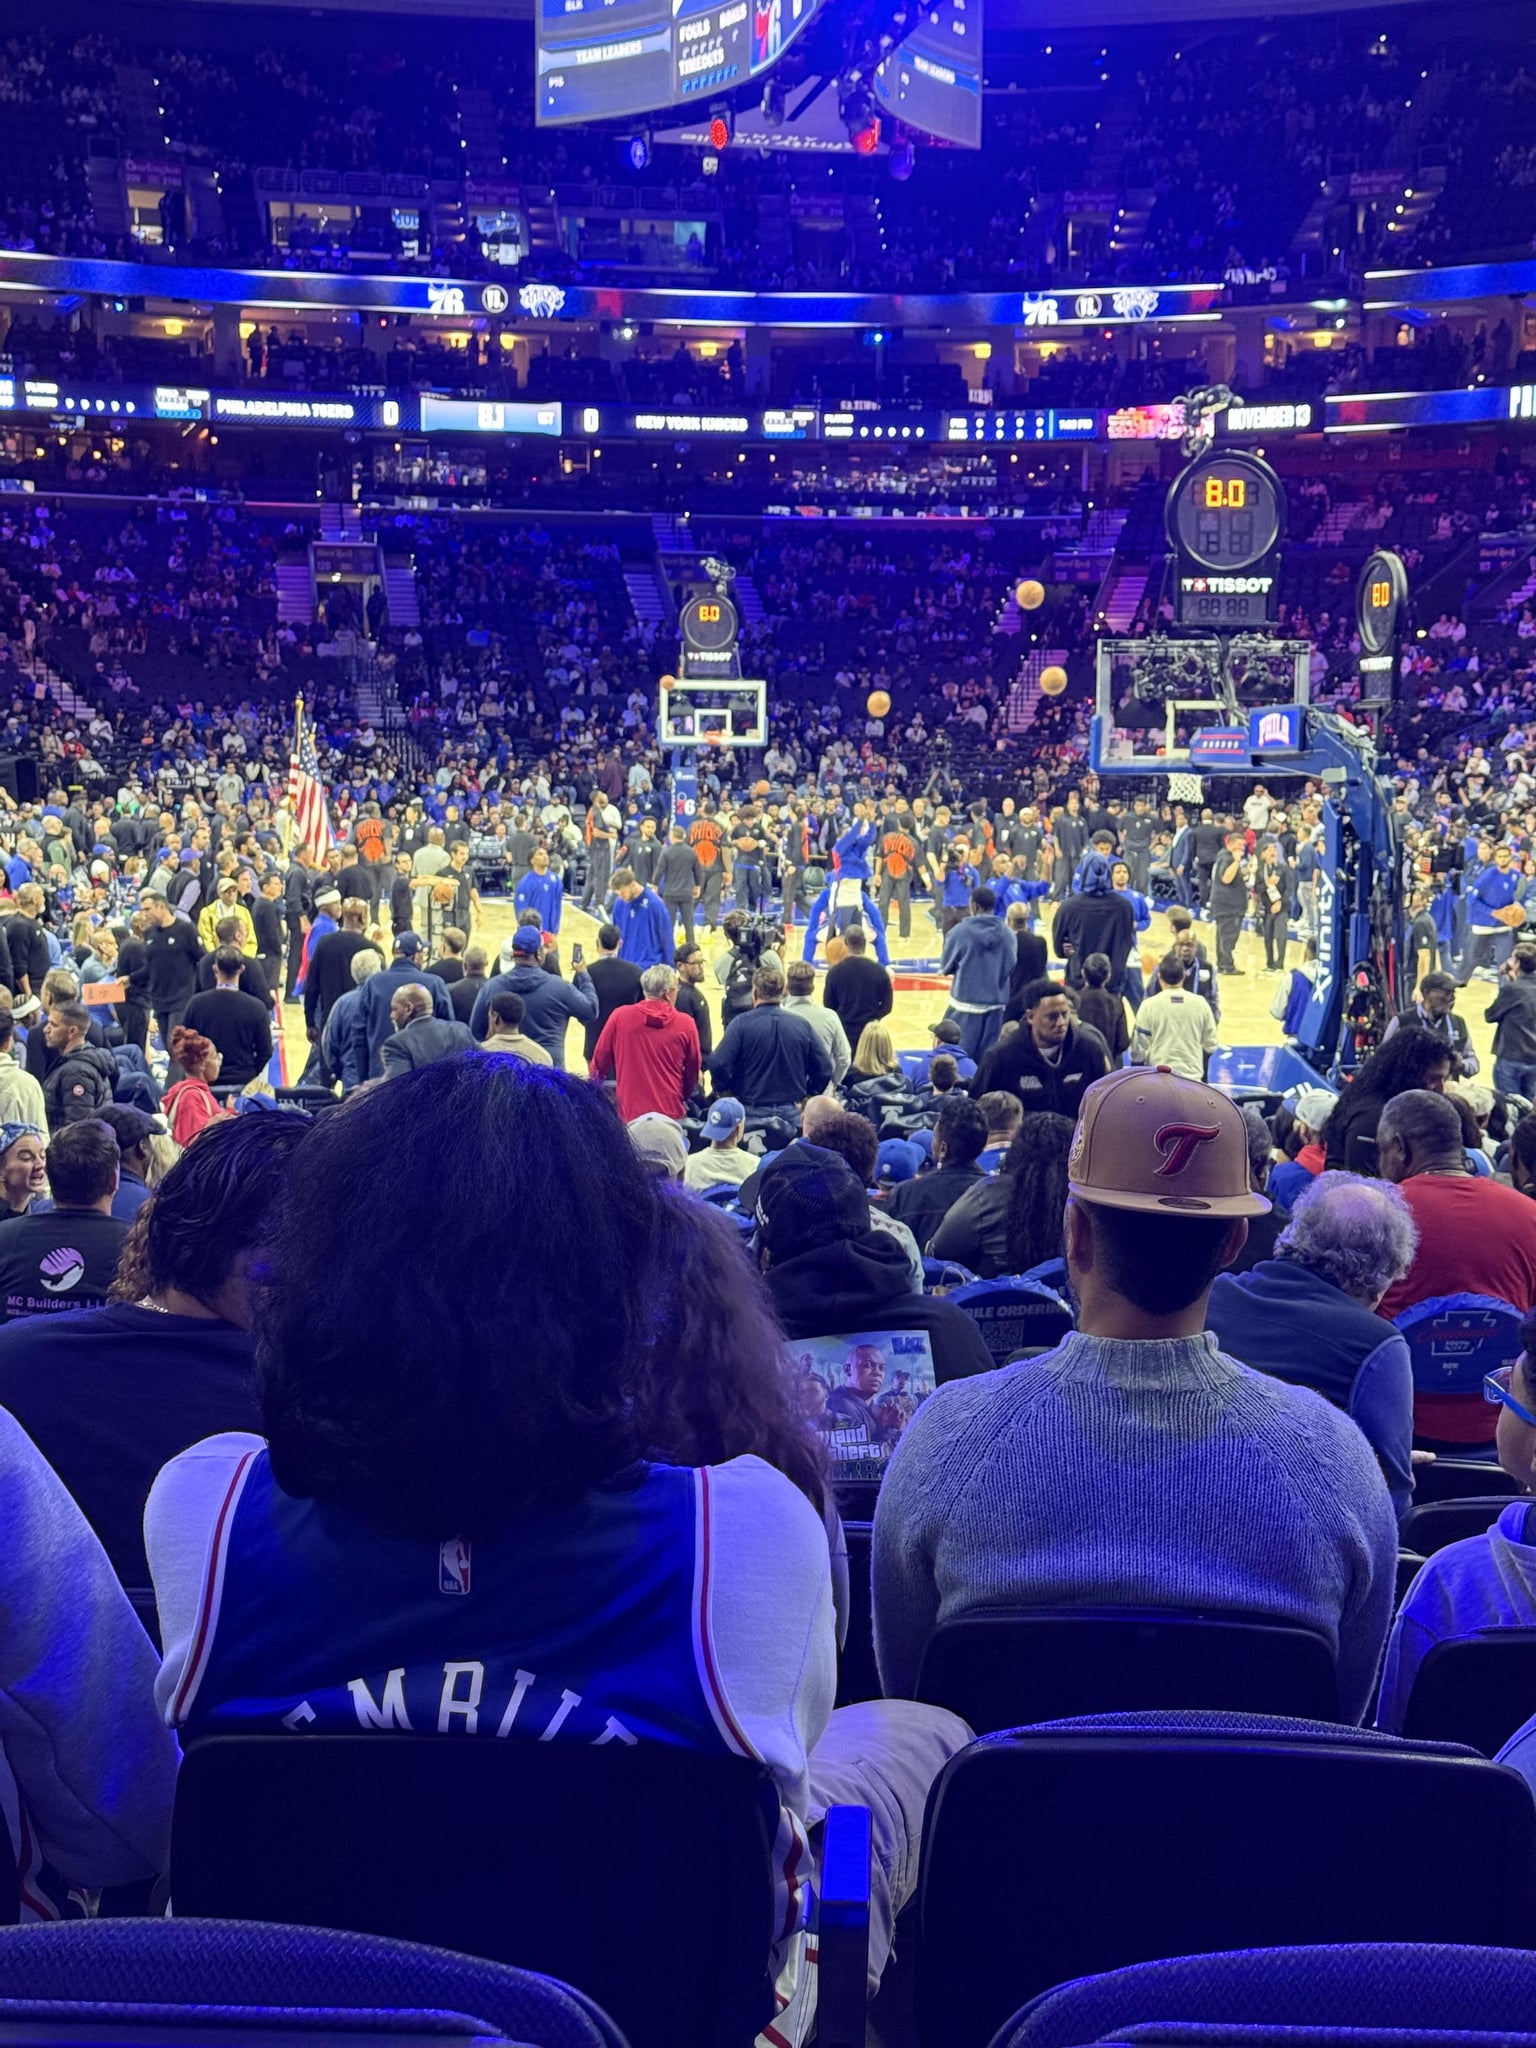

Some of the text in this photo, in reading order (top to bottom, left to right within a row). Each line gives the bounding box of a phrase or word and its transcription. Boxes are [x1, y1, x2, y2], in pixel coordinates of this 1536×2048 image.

[678, 18, 711, 43] FOULS
[576, 40, 643, 64] TEAM LEADERS
[678, 49, 725, 76] TIMEOUTS
[216, 398, 312, 418] PHILADELPHIA
[312, 403, 355, 420] 76ERS
[383, 400, 399, 427] 0
[583, 407, 599, 433] 0
[1227, 403, 1311, 431] NOVEMBER 13
[635, 414, 666, 430] NEW
[666, 415, 701, 431] YORK
[701, 417, 748, 432] KNICKS
[1206, 479, 1245, 508] 8.0
[1207, 577, 1273, 594] TISSOT
[700, 652, 732, 663] TISSOT
[1312, 869, 1336, 1005] xfinity
[7, 1295, 24, 1307] MC
[26, 1297, 81, 1310] Builders
[996, 1303, 1062, 1318] ORDERIN
